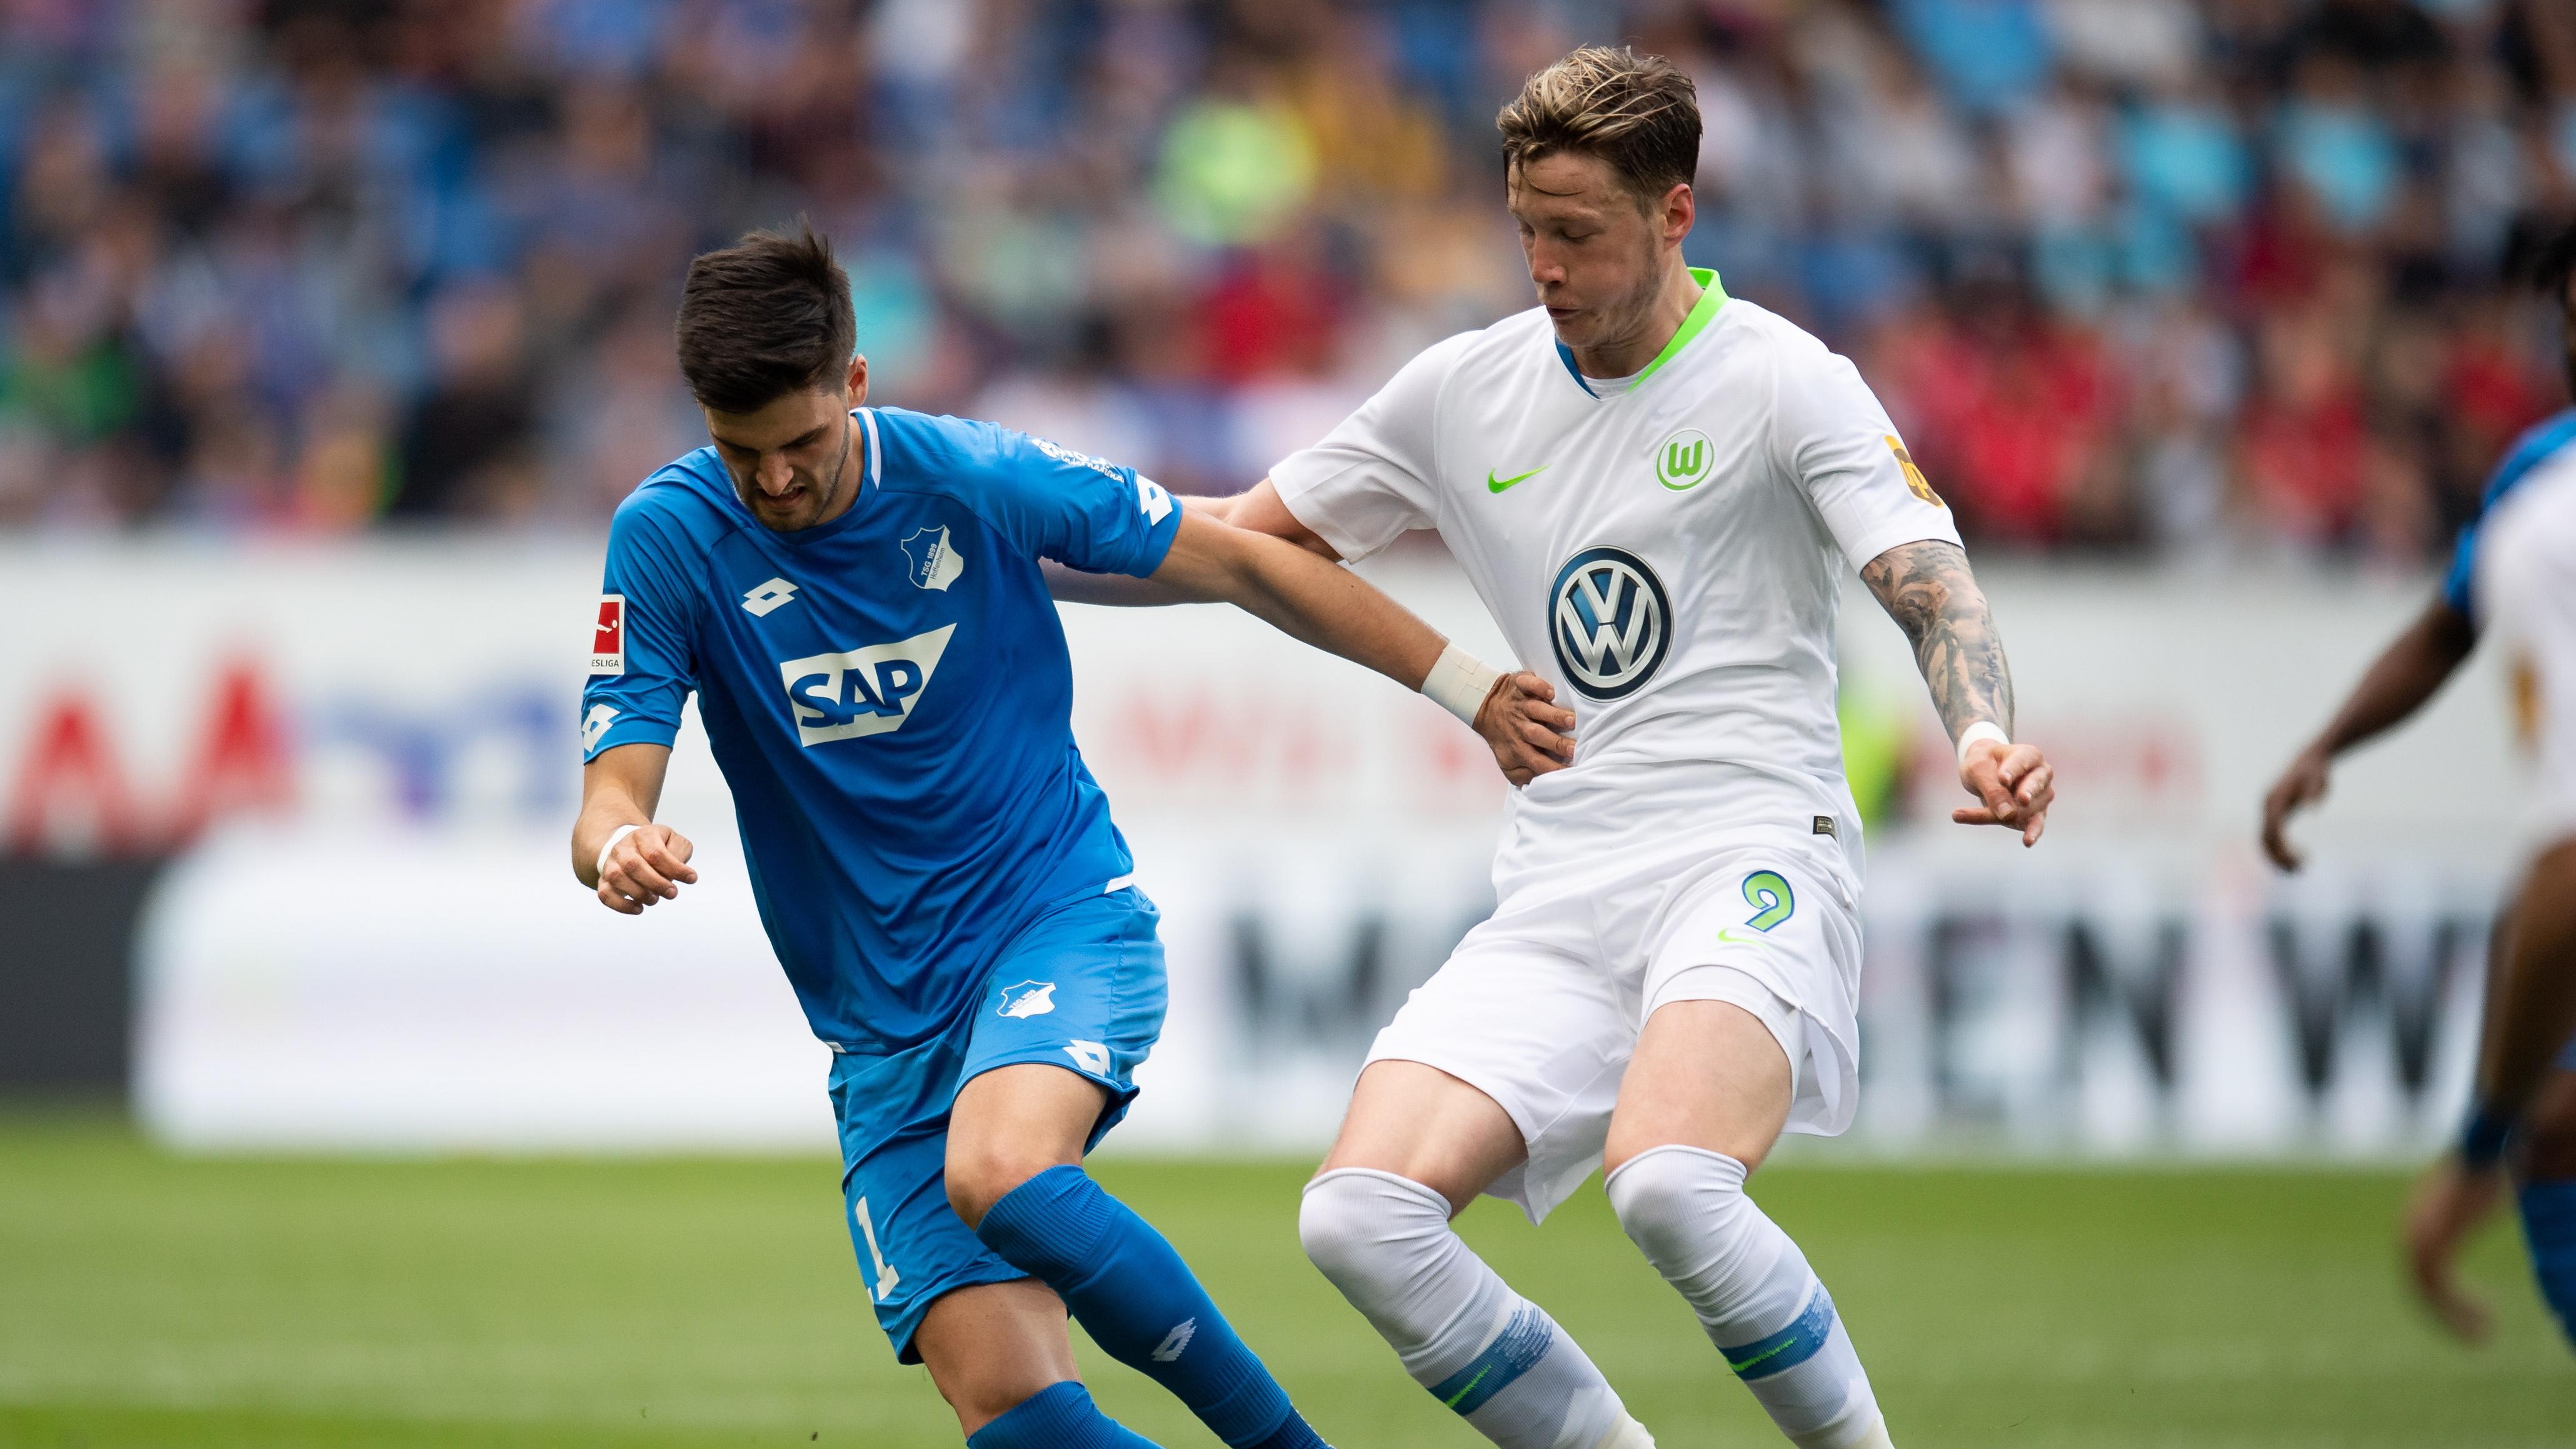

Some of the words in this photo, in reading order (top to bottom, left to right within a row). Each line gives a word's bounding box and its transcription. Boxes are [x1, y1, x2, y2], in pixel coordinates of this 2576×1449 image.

[1667, 439, 1703, 477] W
[921, 561, 931, 576] TSG
[927, 543, 937, 559] 1899
[930, 547, 946, 580] Hoffenheim
[1556, 560, 1661, 688] VW
[790, 659, 923, 728] SAP
[1742, 870, 1795, 933] 9
[855, 1196, 900, 1305] 1
